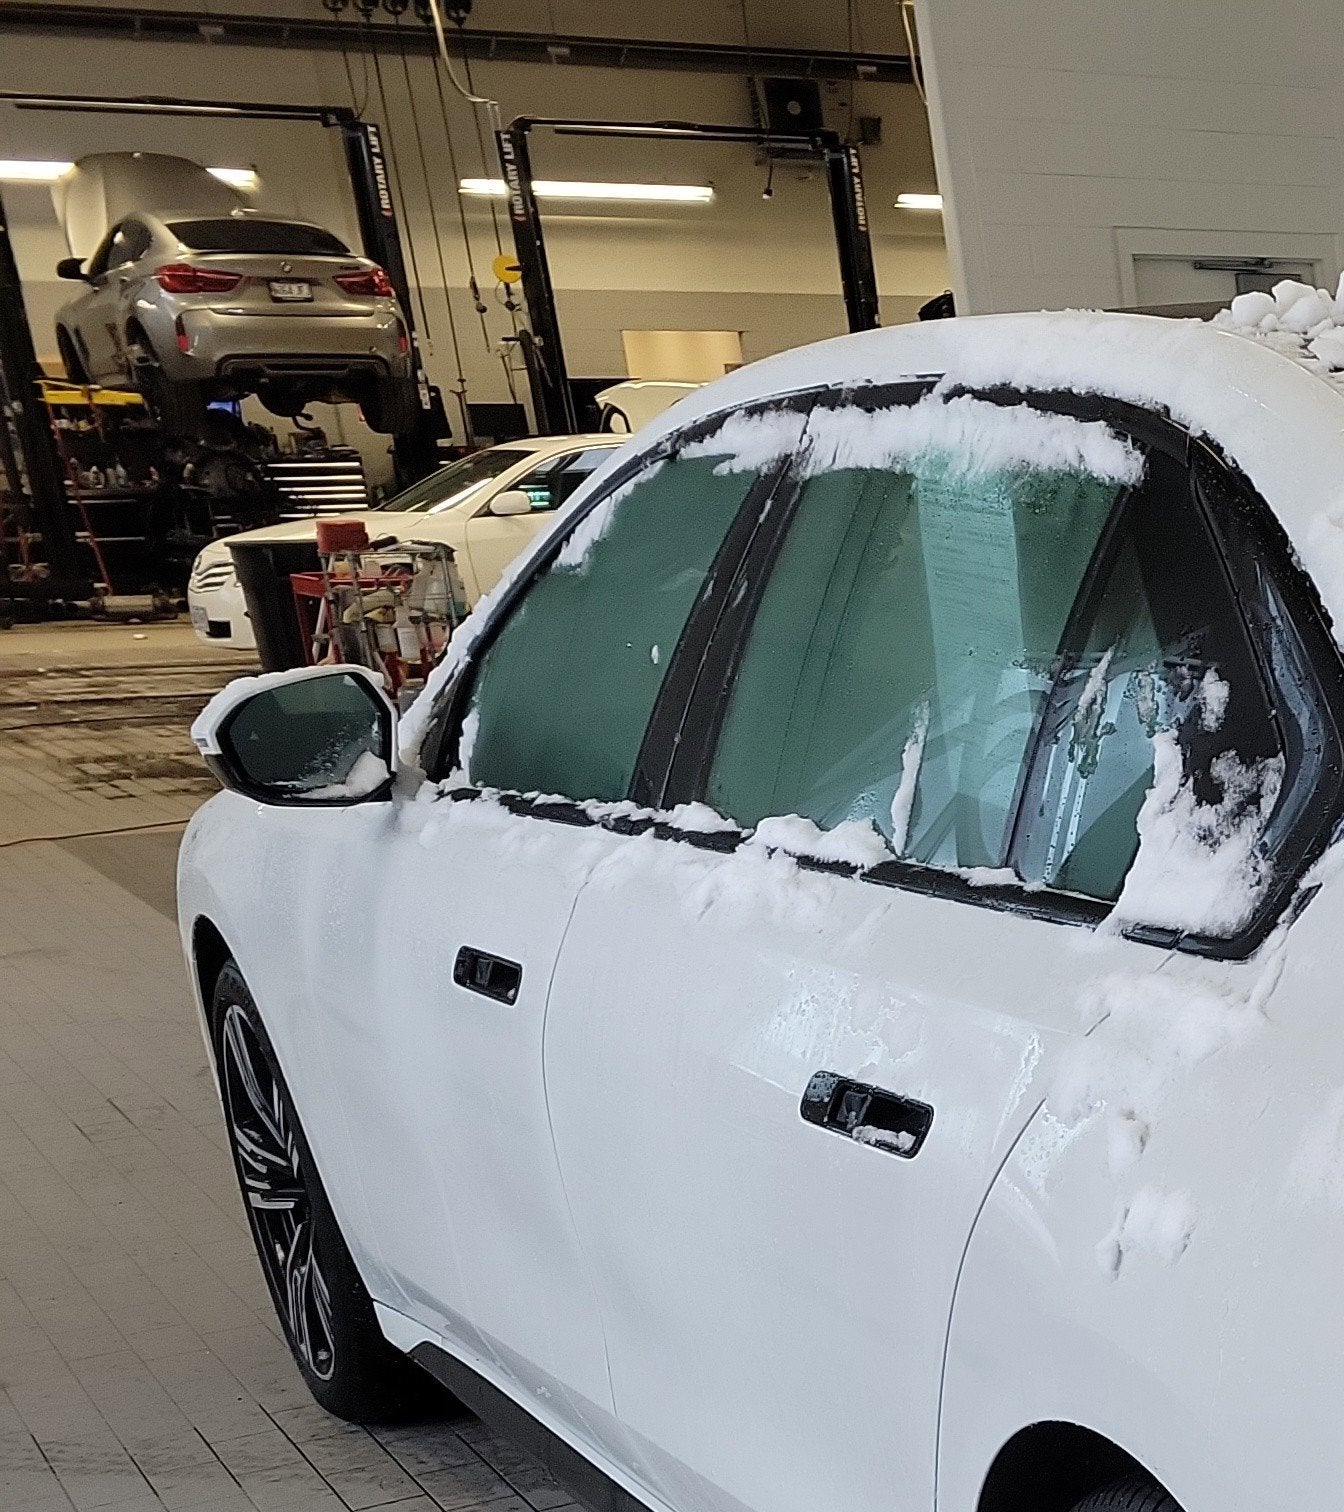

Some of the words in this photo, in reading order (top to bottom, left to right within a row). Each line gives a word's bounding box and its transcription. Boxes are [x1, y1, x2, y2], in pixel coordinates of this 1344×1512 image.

[366, 125, 381, 153] LIFT
[500, 133, 515, 160] LIFT
[373, 156, 391, 209] ROTARY
[505, 162, 526, 214] ROTARY
